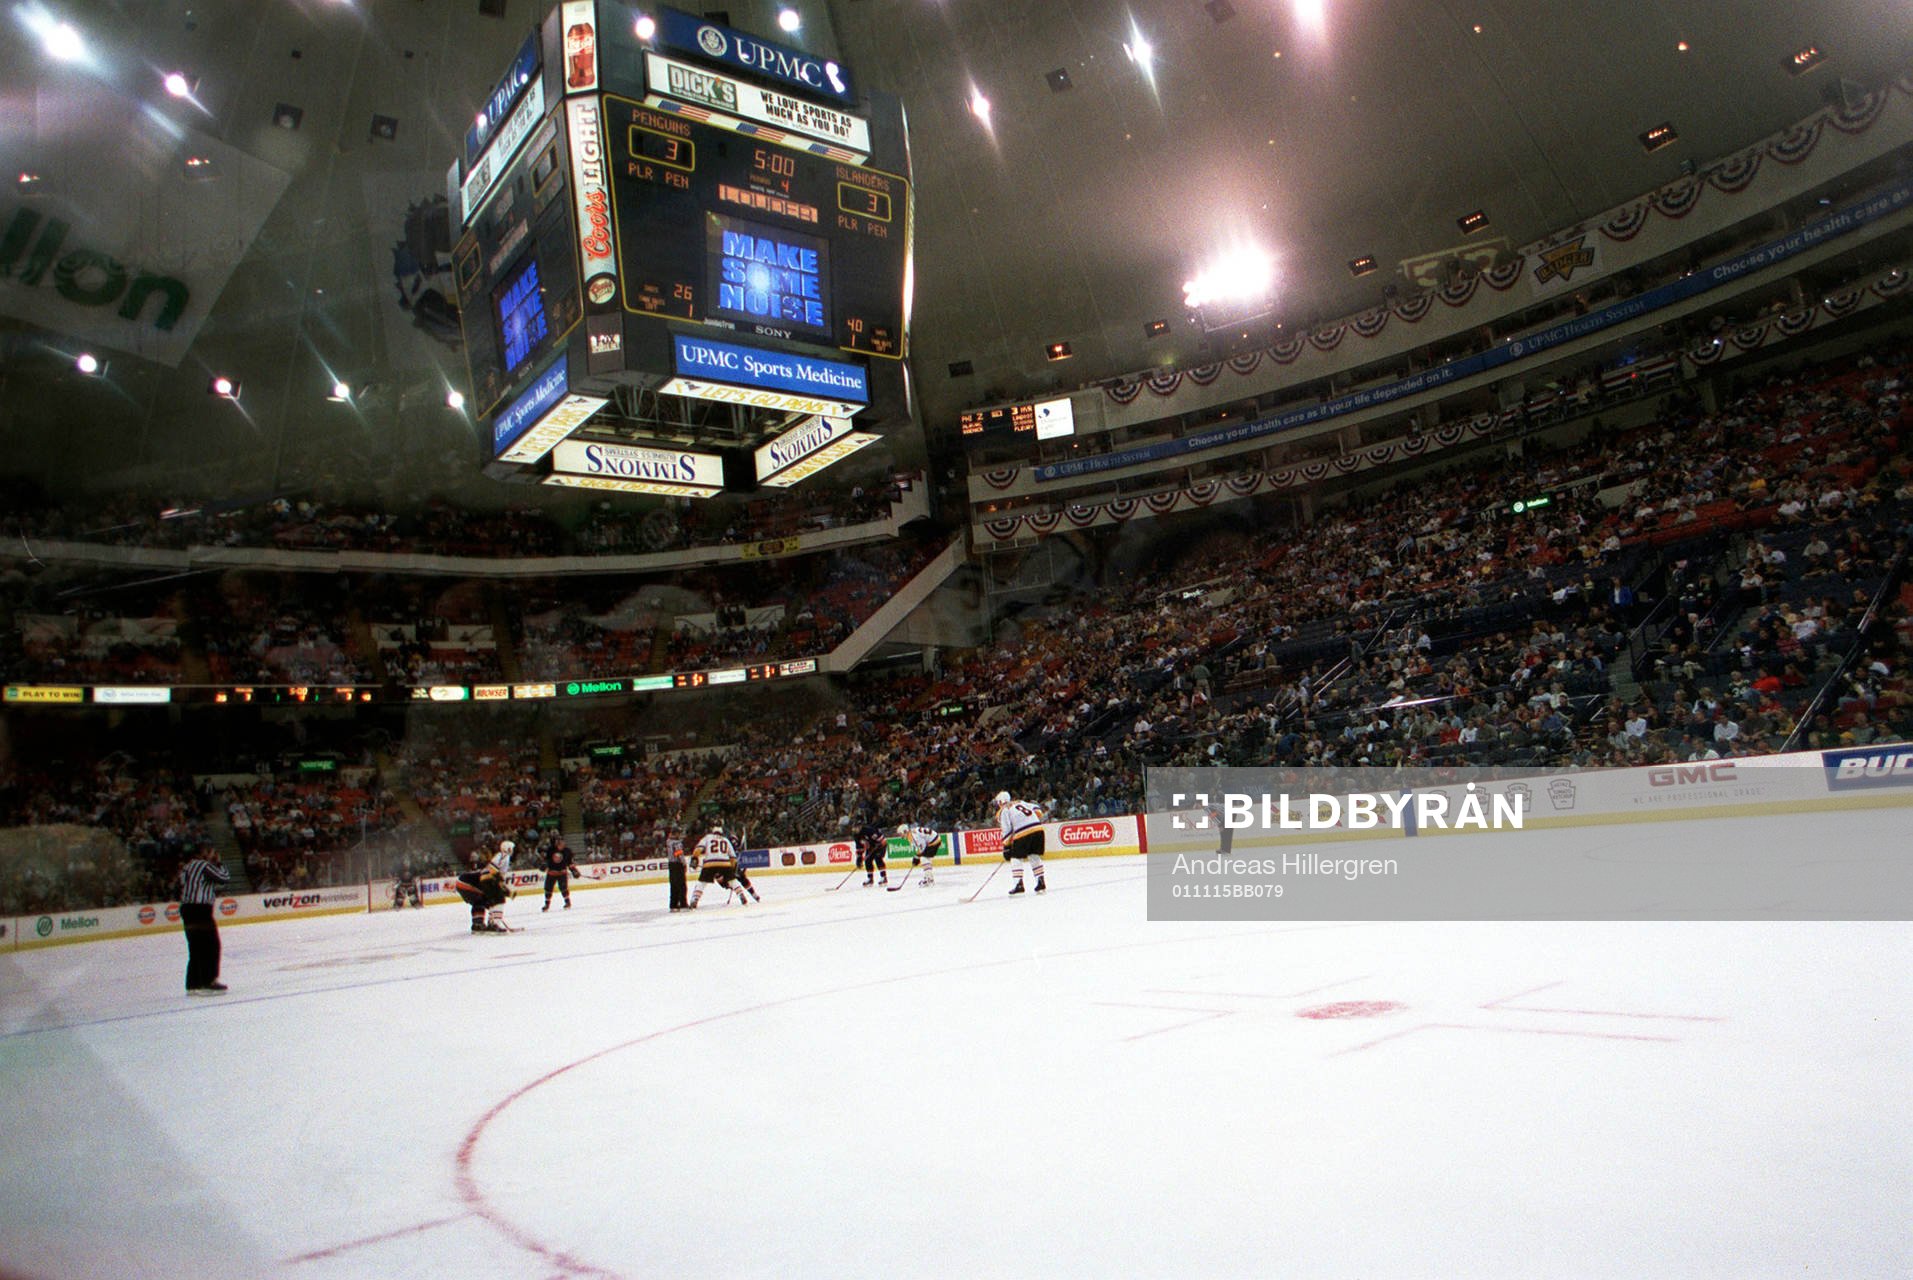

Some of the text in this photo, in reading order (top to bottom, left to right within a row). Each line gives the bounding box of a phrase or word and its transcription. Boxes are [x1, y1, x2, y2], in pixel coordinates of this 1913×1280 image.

[734, 36, 822, 87] UPMC
[489, 58, 524, 124] UPMC
[670, 66, 735, 103] DICK'S
[760, 91, 852, 128] WE LOVE SPORTS AS
[765, 104, 793, 121] MUCH
[797, 113, 808, 126] AS
[812, 119, 830, 132] YOU
[834, 123, 850, 137] DO!
[632, 109, 691, 138] PENGUINS
[577, 103, 605, 187] LIGHT
[665, 139, 678, 161] 3
[628, 162, 653, 181] PLR
[754, 150, 795, 178] 5:00
[780, 179, 790, 193] 4
[835, 166, 890, 191] ISLANDERS
[867, 193, 878, 213] 3
[583, 188, 612, 259] Coors
[838, 214, 858, 231] PLR
[1713, 252, 1765, 279] Choose
[1767, 236, 1801, 259] your
[1803, 214, 1850, 243] health
[1854, 198, 1888, 220] care
[722, 230, 819, 274] MAKE
[722, 257, 820, 300] SOME
[673, 283, 693, 300] 26
[689, 303, 694, 318] 1
[719, 283, 825, 327] NOISE
[755, 324, 792, 340] SONY
[847, 319, 863, 333] 40
[851, 333, 856, 347] 1
[681, 343, 862, 390] UPMC Sports Medicine
[700, 385, 752, 404] LET'S
[781, 397, 830, 413] PENS
[1011, 406, 1019, 415] 3
[1188, 433, 1225, 449] Choose
[1226, 427, 1249, 440] your
[1250, 419, 1282, 436] health
[1283, 414, 1305, 426] care
[1306, 409, 1319, 419] as
[1319, 406, 1328, 416] if
[1329, 399, 1352, 414] your
[1354, 393, 1370, 406] life
[1372, 377, 1424, 401] depended
[1426, 373, 1440, 384] on
[770, 415, 833, 470] SIMMONS
[585, 444, 696, 482] SIMMONS
[22, 690, 45, 698] PLAY
[48, 690, 60, 698] TO
[582, 682, 622, 693] Mellon
[1648, 762, 1738, 787] GMC
[710, 839, 728, 854] 20
[609, 862, 669, 875] DODGE
[263, 893, 321, 909] verizon
[61, 916, 99, 931] Mellon
